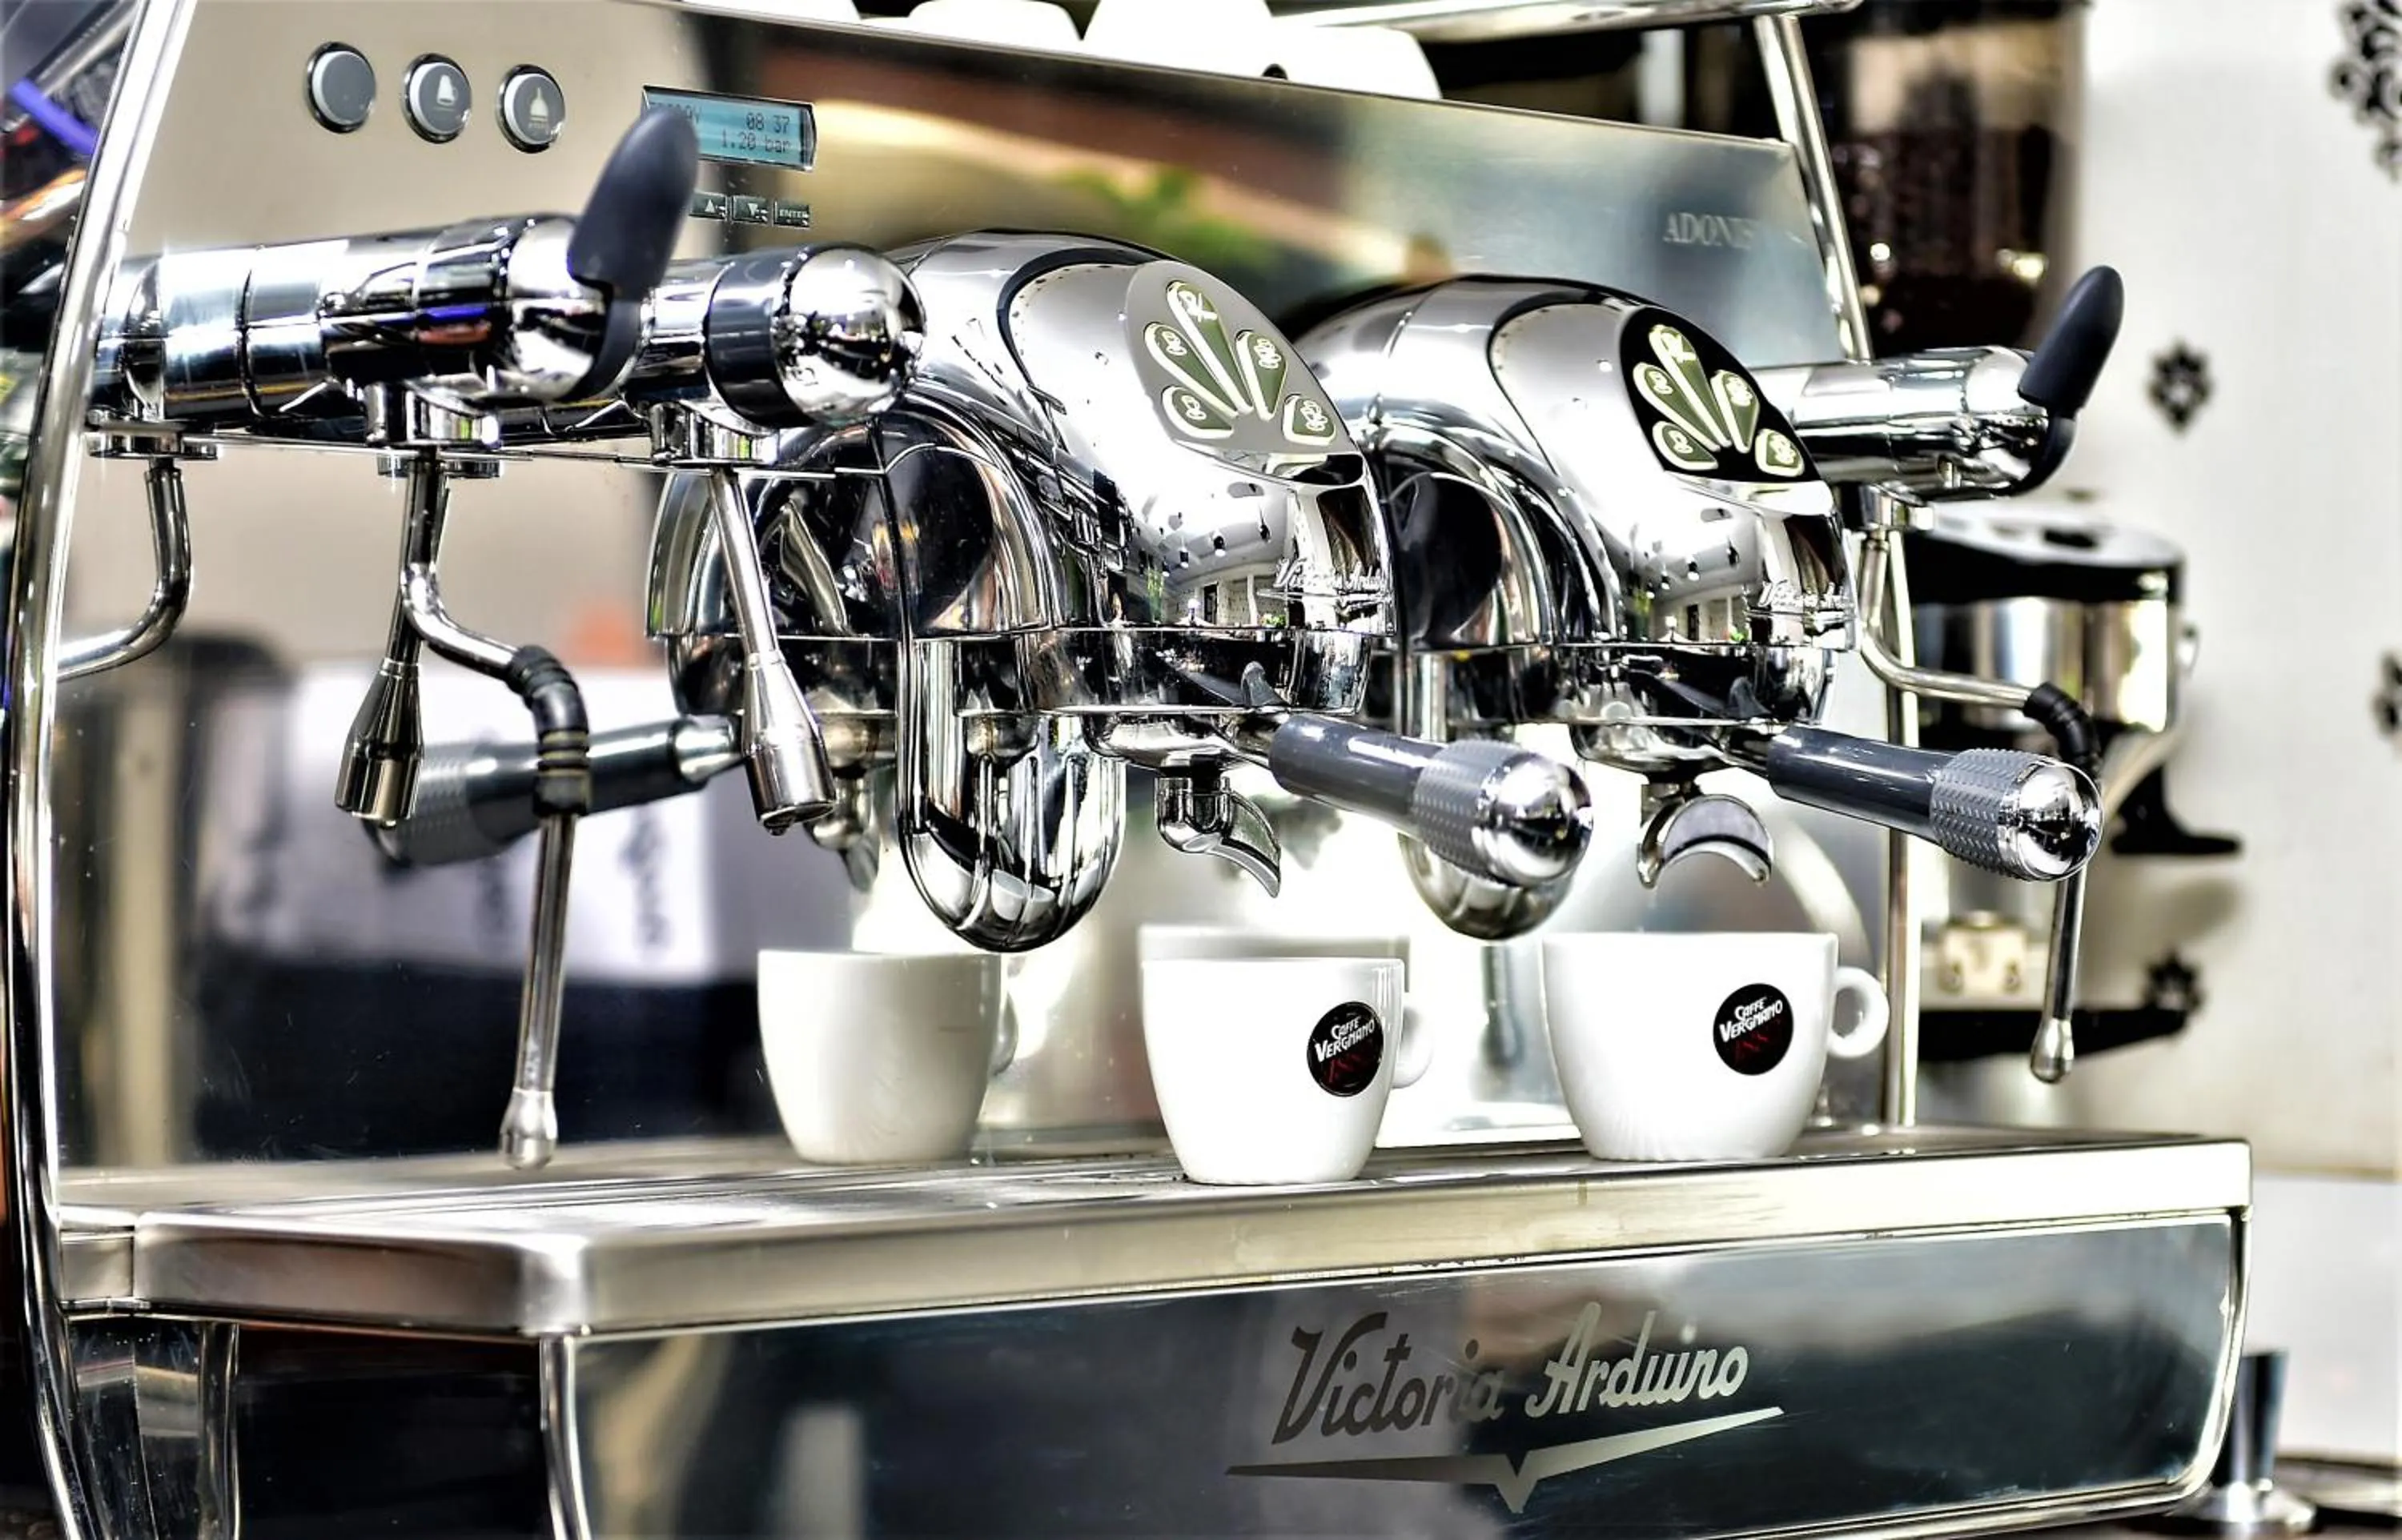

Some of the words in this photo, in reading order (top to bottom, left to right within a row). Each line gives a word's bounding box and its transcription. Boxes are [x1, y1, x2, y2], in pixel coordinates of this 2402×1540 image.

[773, 114, 790, 134] 37
[765, 134, 791, 153] bar
[1314, 1019, 1376, 1062] VERGNANO
[1271, 1311, 1506, 1445] Victoria
[1524, 1301, 1749, 1418] Arduino
